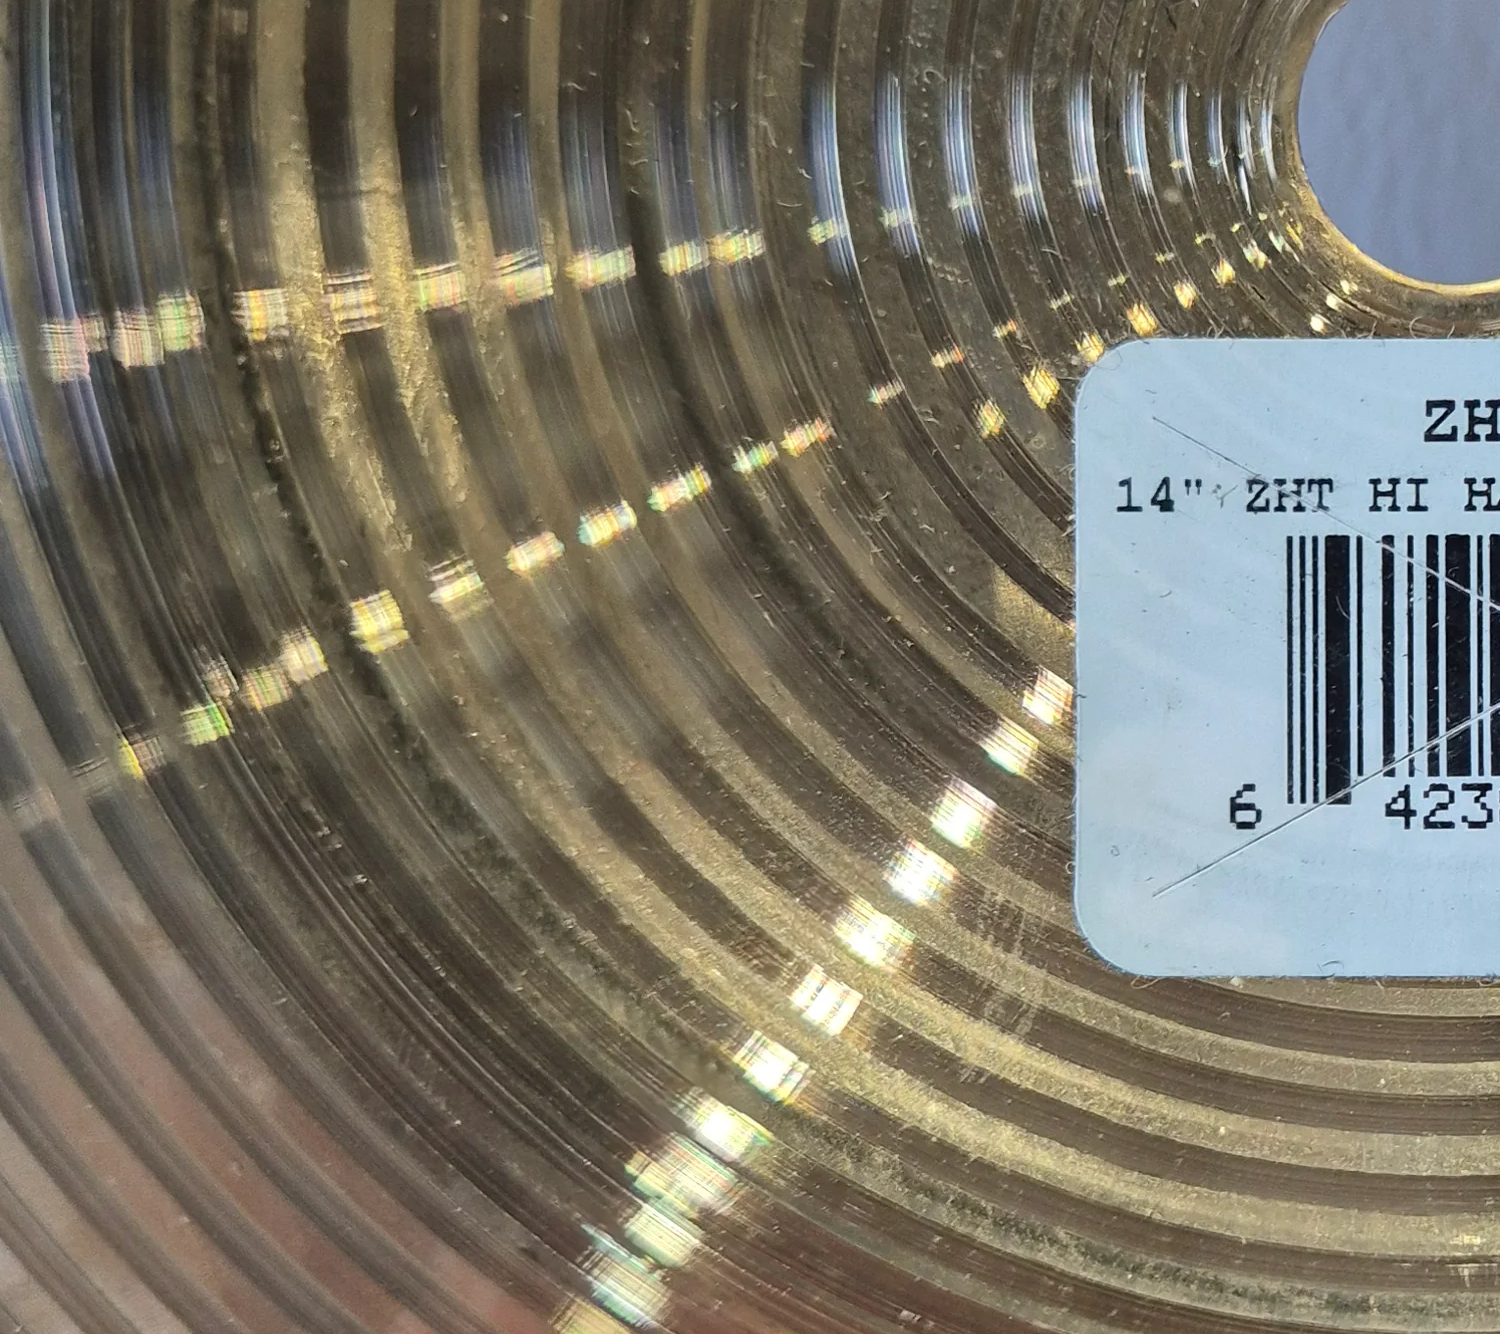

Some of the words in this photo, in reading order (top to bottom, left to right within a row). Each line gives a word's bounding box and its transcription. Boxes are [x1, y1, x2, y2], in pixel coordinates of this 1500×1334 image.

[1116, 476, 1202, 513] 14"
[1245, 477, 1335, 515] ZHT
[1367, 477, 1430, 513] HI
[1229, 783, 1262, 830] 6
